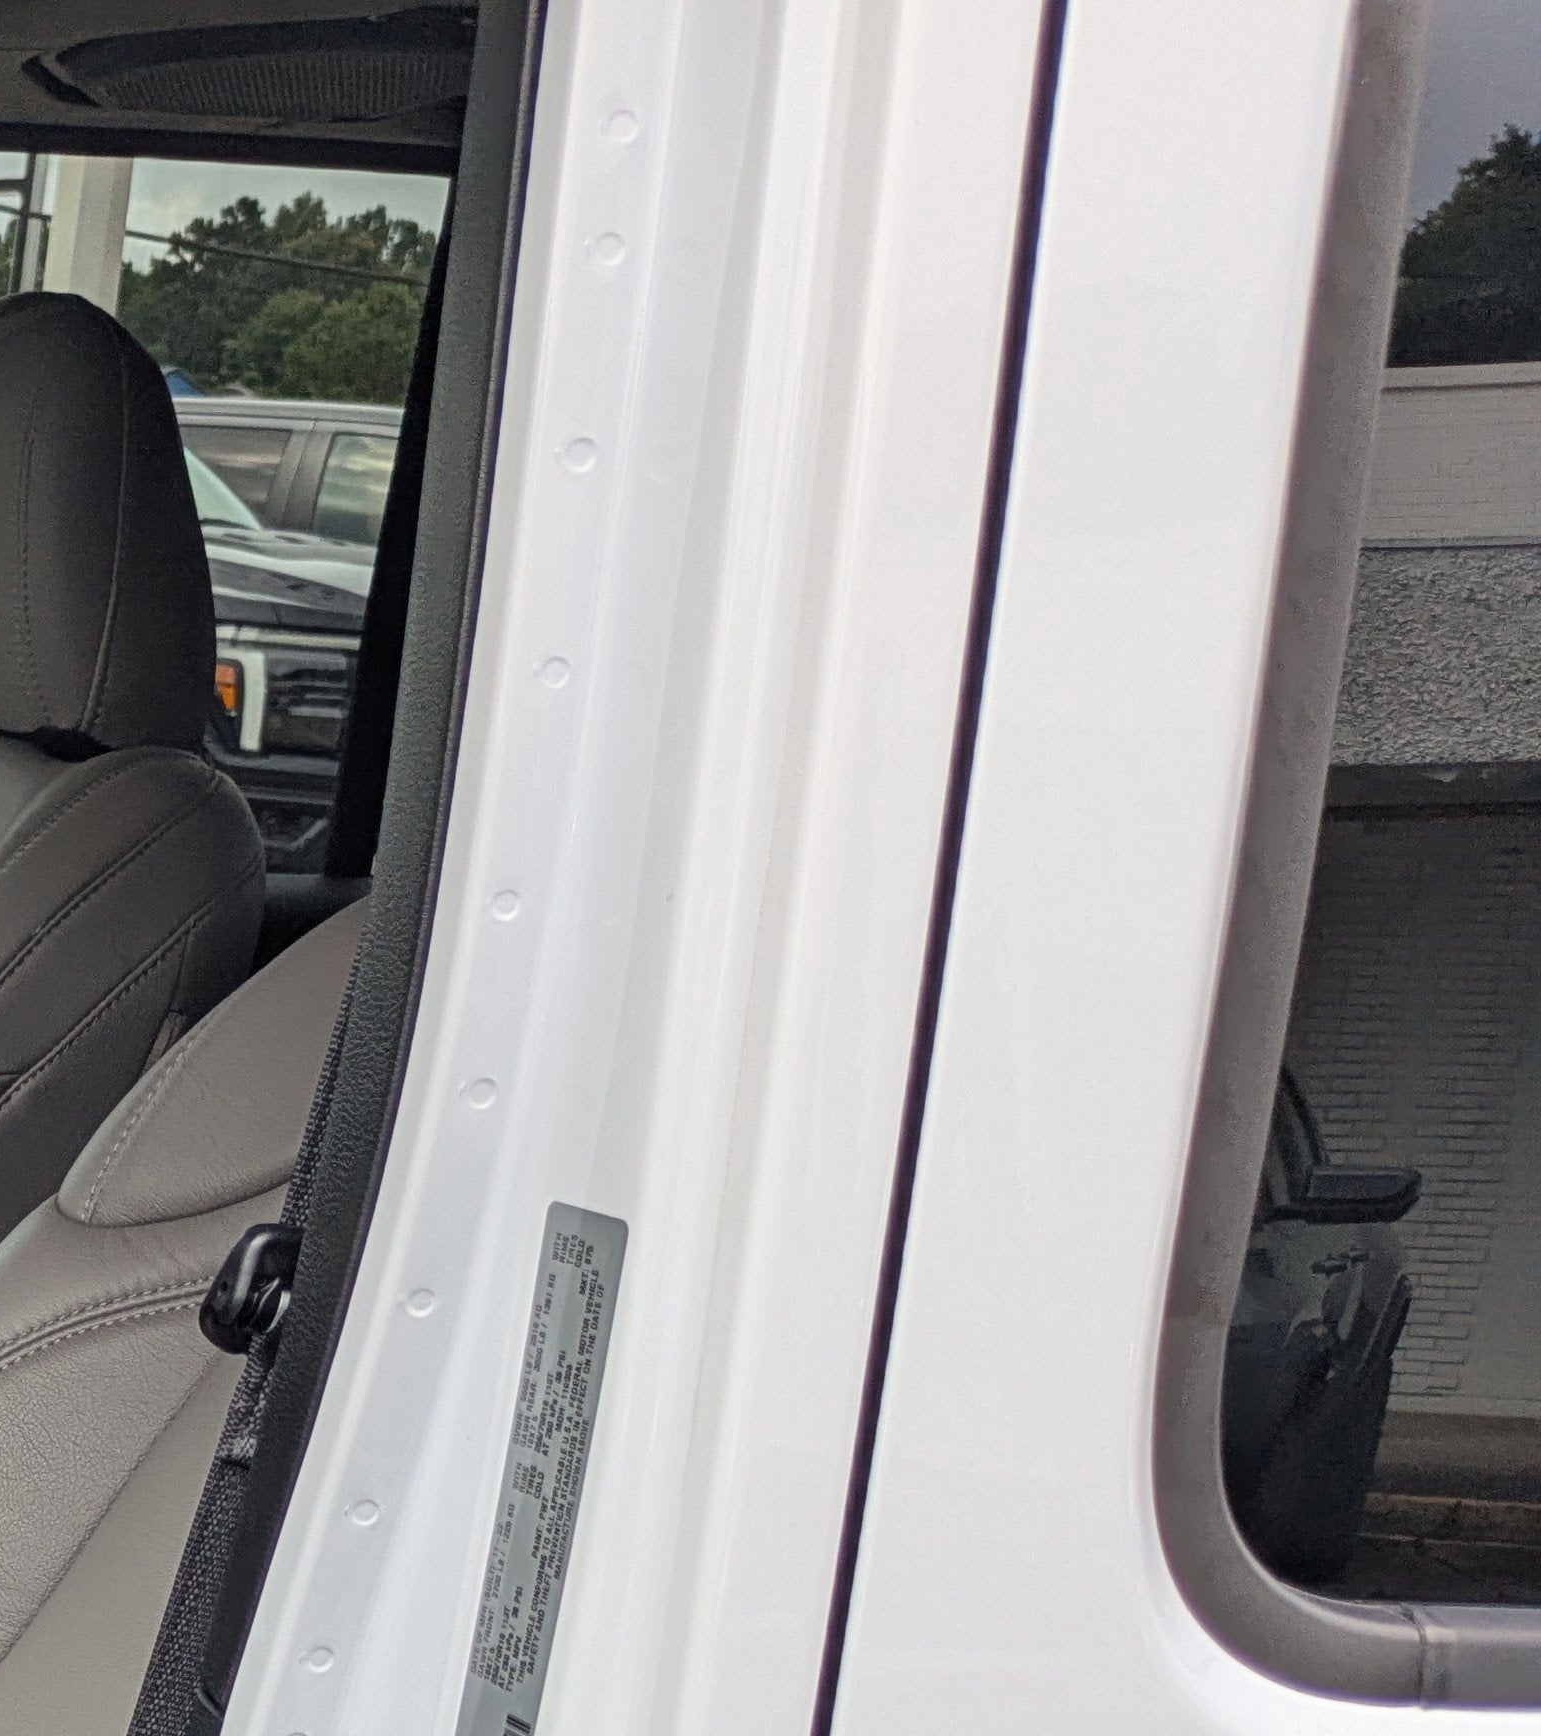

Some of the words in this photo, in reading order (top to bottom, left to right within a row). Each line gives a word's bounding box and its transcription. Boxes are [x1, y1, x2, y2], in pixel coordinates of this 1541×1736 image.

[552, 1232, 563, 1260] WITH
[575, 1240, 585, 1268] COLD
[585, 1270, 599, 1314] VEHICLE
[596, 1284, 604, 1298] OF
[591, 1302, 602, 1330] DATE
[578, 1318, 591, 1356] MOTOR
[586, 1334, 596, 1354] THE
[583, 1359, 591, 1374] ON
[569, 1362, 583, 1408] FEDERAL
[575, 1377, 588, 1418] EFFECT
[573, 1421, 581, 1432] IN
[542, 1442, 549, 1456] AT
[526, 1466, 537, 1494] TIRES
[550, 1448, 567, 1512] APPLICABLE
[561, 1436, 578, 1500] STANDARDS
[569, 1457, 582, 1497] SHOWN
[533, 1472, 545, 1499] COLD
[539, 1496, 549, 1520] PW7
[546, 1516, 555, 1534] ALL
[547, 1503, 565, 1570] PREVENTION
[542, 1538, 550, 1550] TO
[531, 1554, 547, 1612] CONFORMS
[540, 1574, 551, 1606] THEFT
[535, 1610, 545, 1632] AND
[512, 1636, 522, 1659] MPV
[522, 1615, 535, 1657] VEHICLE
[527, 1635, 539, 1675] SAFETY
[498, 1676, 505, 1689] AT
[516, 1660, 527, 1683] THIS
